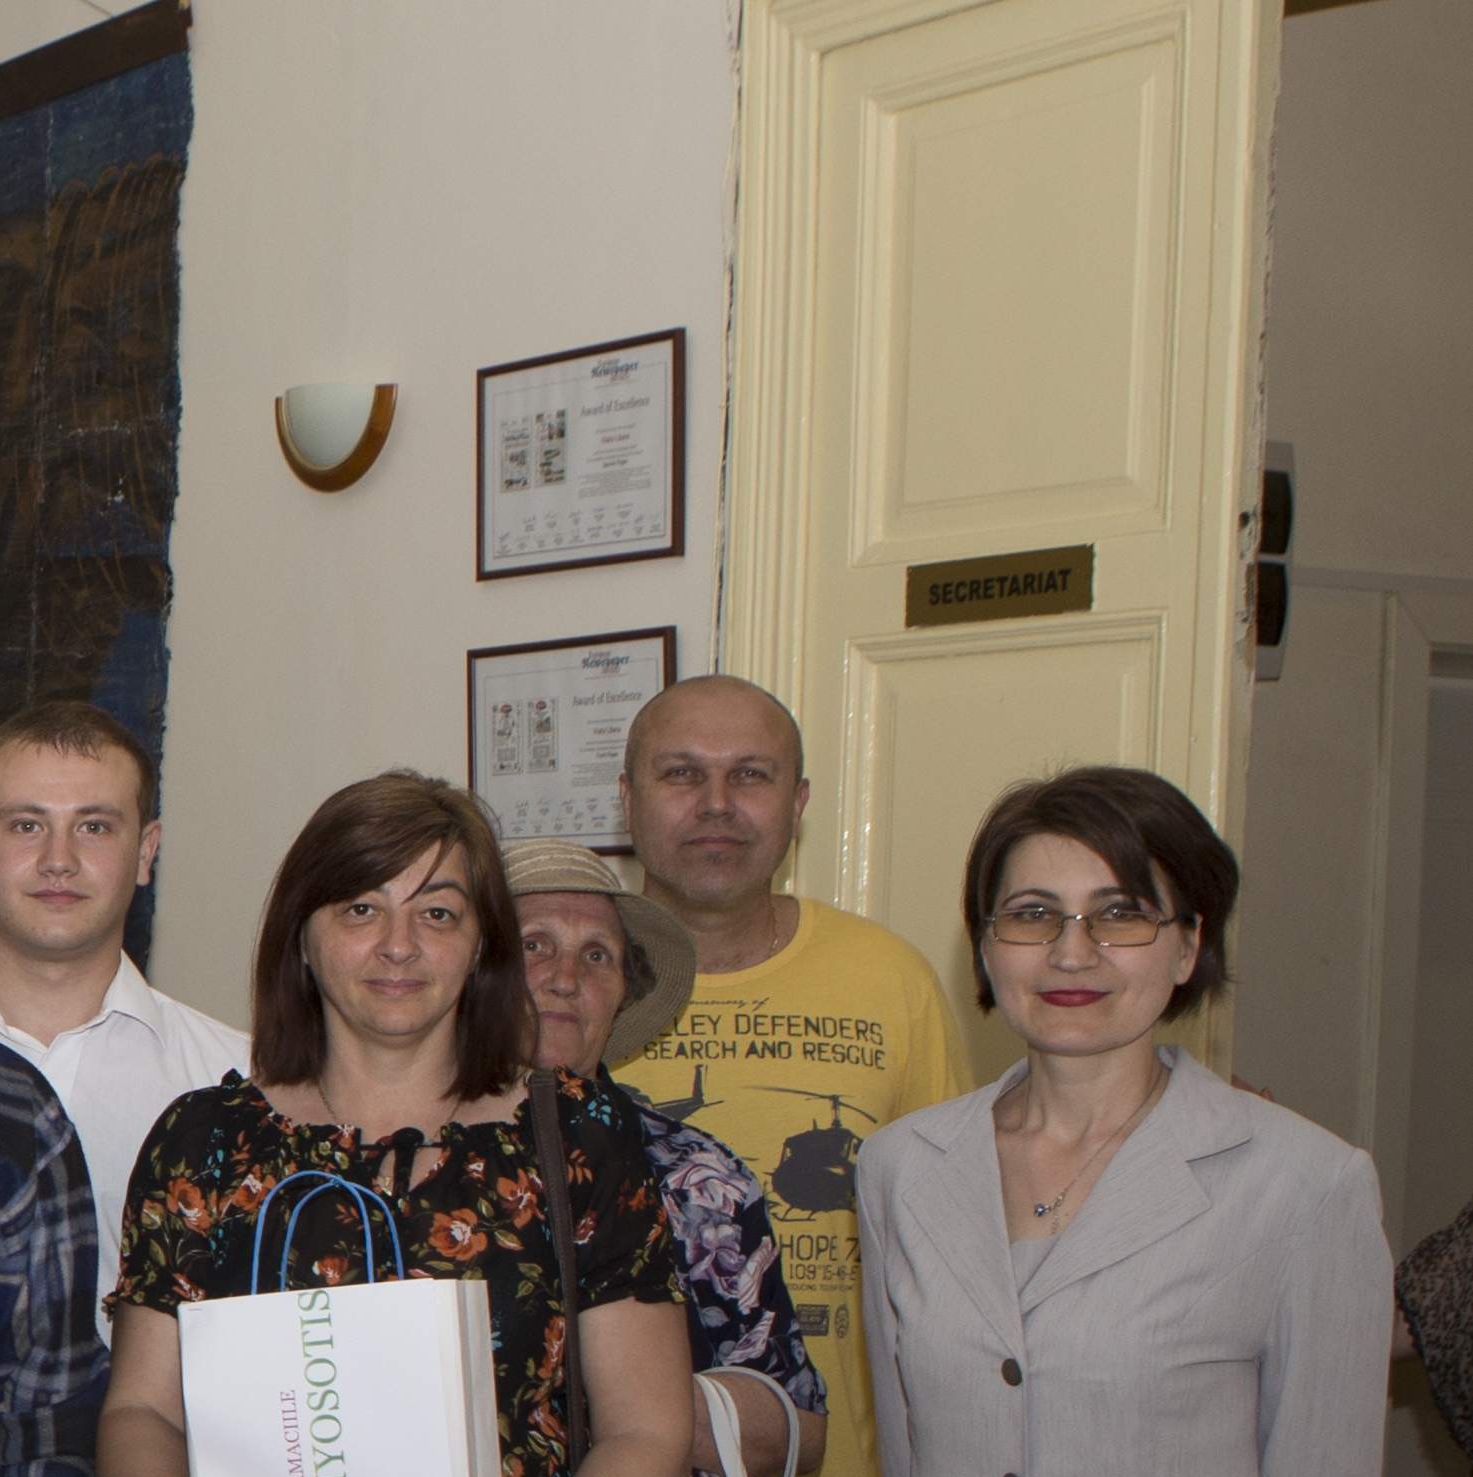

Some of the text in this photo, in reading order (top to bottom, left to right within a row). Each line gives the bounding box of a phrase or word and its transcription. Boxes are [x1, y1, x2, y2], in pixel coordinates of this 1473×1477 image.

[929, 567, 1072, 606] SECRETARIAT
[735, 1013, 884, 1046] DEFENDERS
[644, 1039, 887, 1070] SEARCH AND RESCUE
[779, 1234, 838, 1261] HOPE
